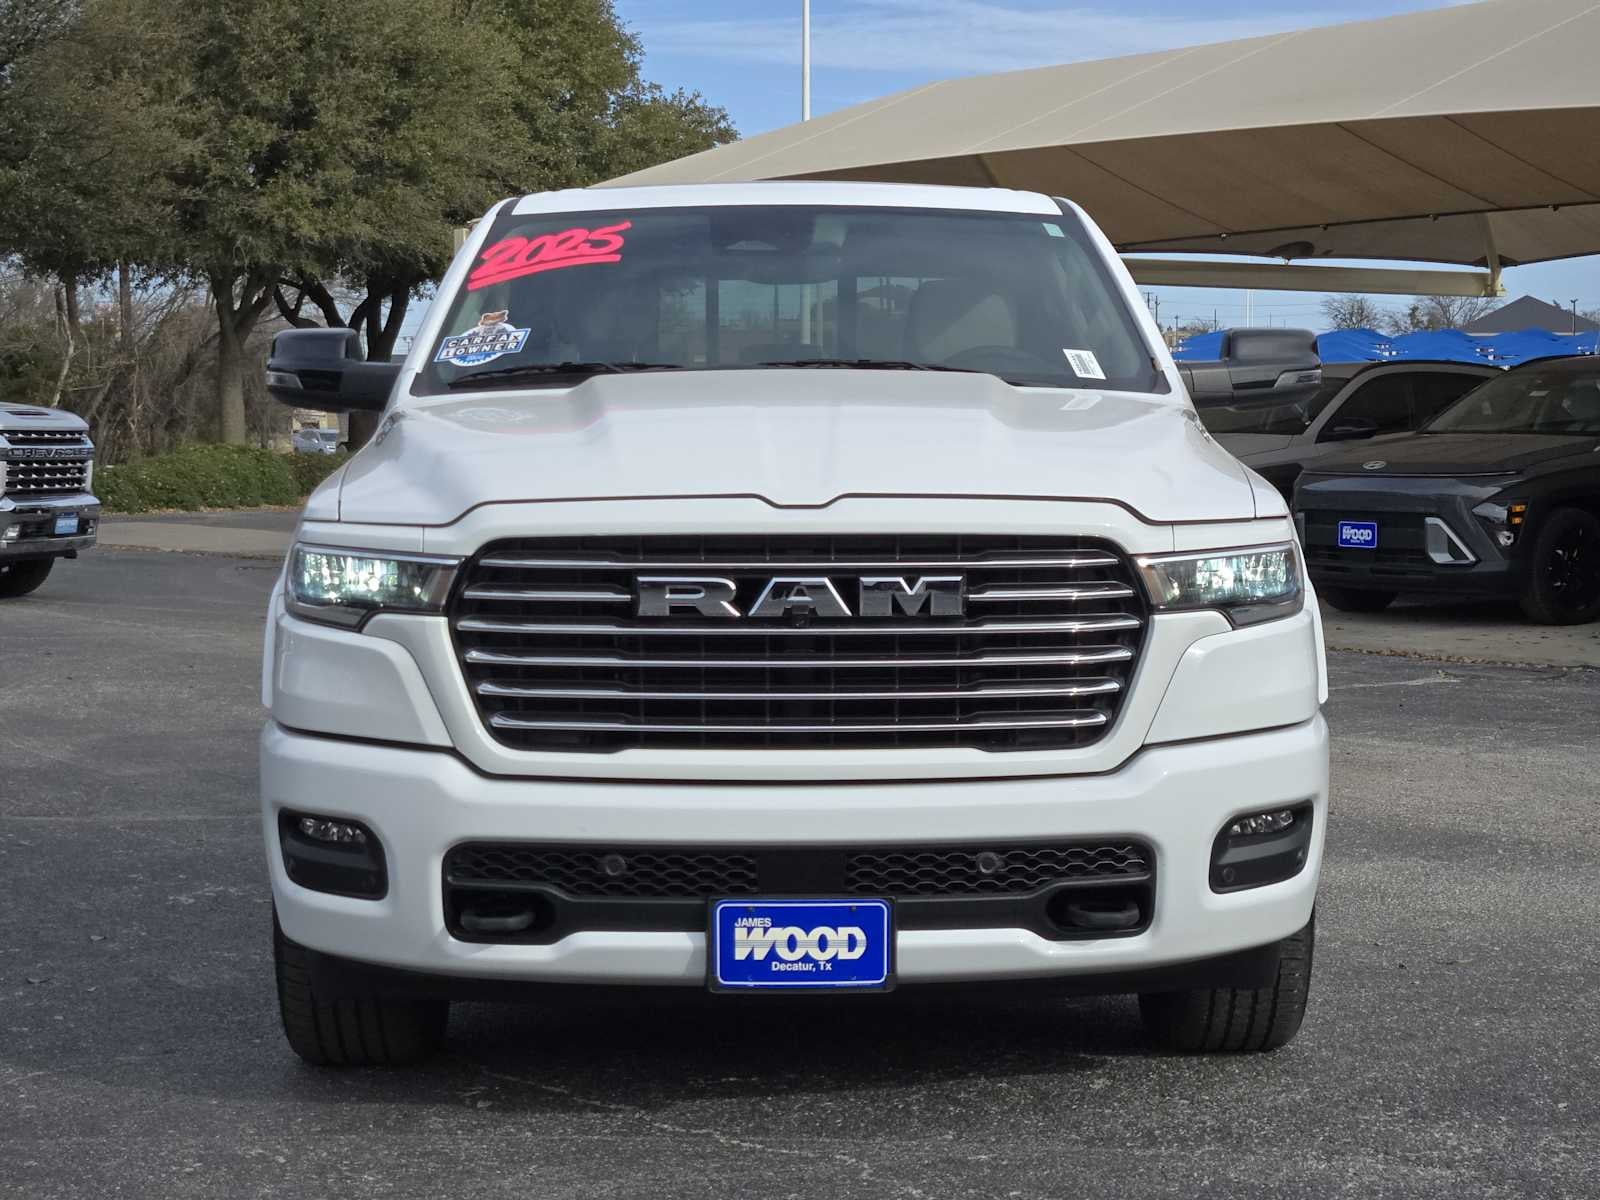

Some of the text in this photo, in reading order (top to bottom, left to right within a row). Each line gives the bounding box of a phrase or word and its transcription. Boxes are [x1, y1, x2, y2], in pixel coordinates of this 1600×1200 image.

[469, 220, 632, 280] 2025
[448, 334, 521, 347] CARFAX
[456, 342, 517, 355] OWNER
[1342, 528, 1372, 540] WOOD
[637, 576, 963, 616] RAM
[734, 917, 772, 927] JAMES
[734, 926, 867, 961] WOOD
[771, 961, 832, 972] Decatur, Tx
